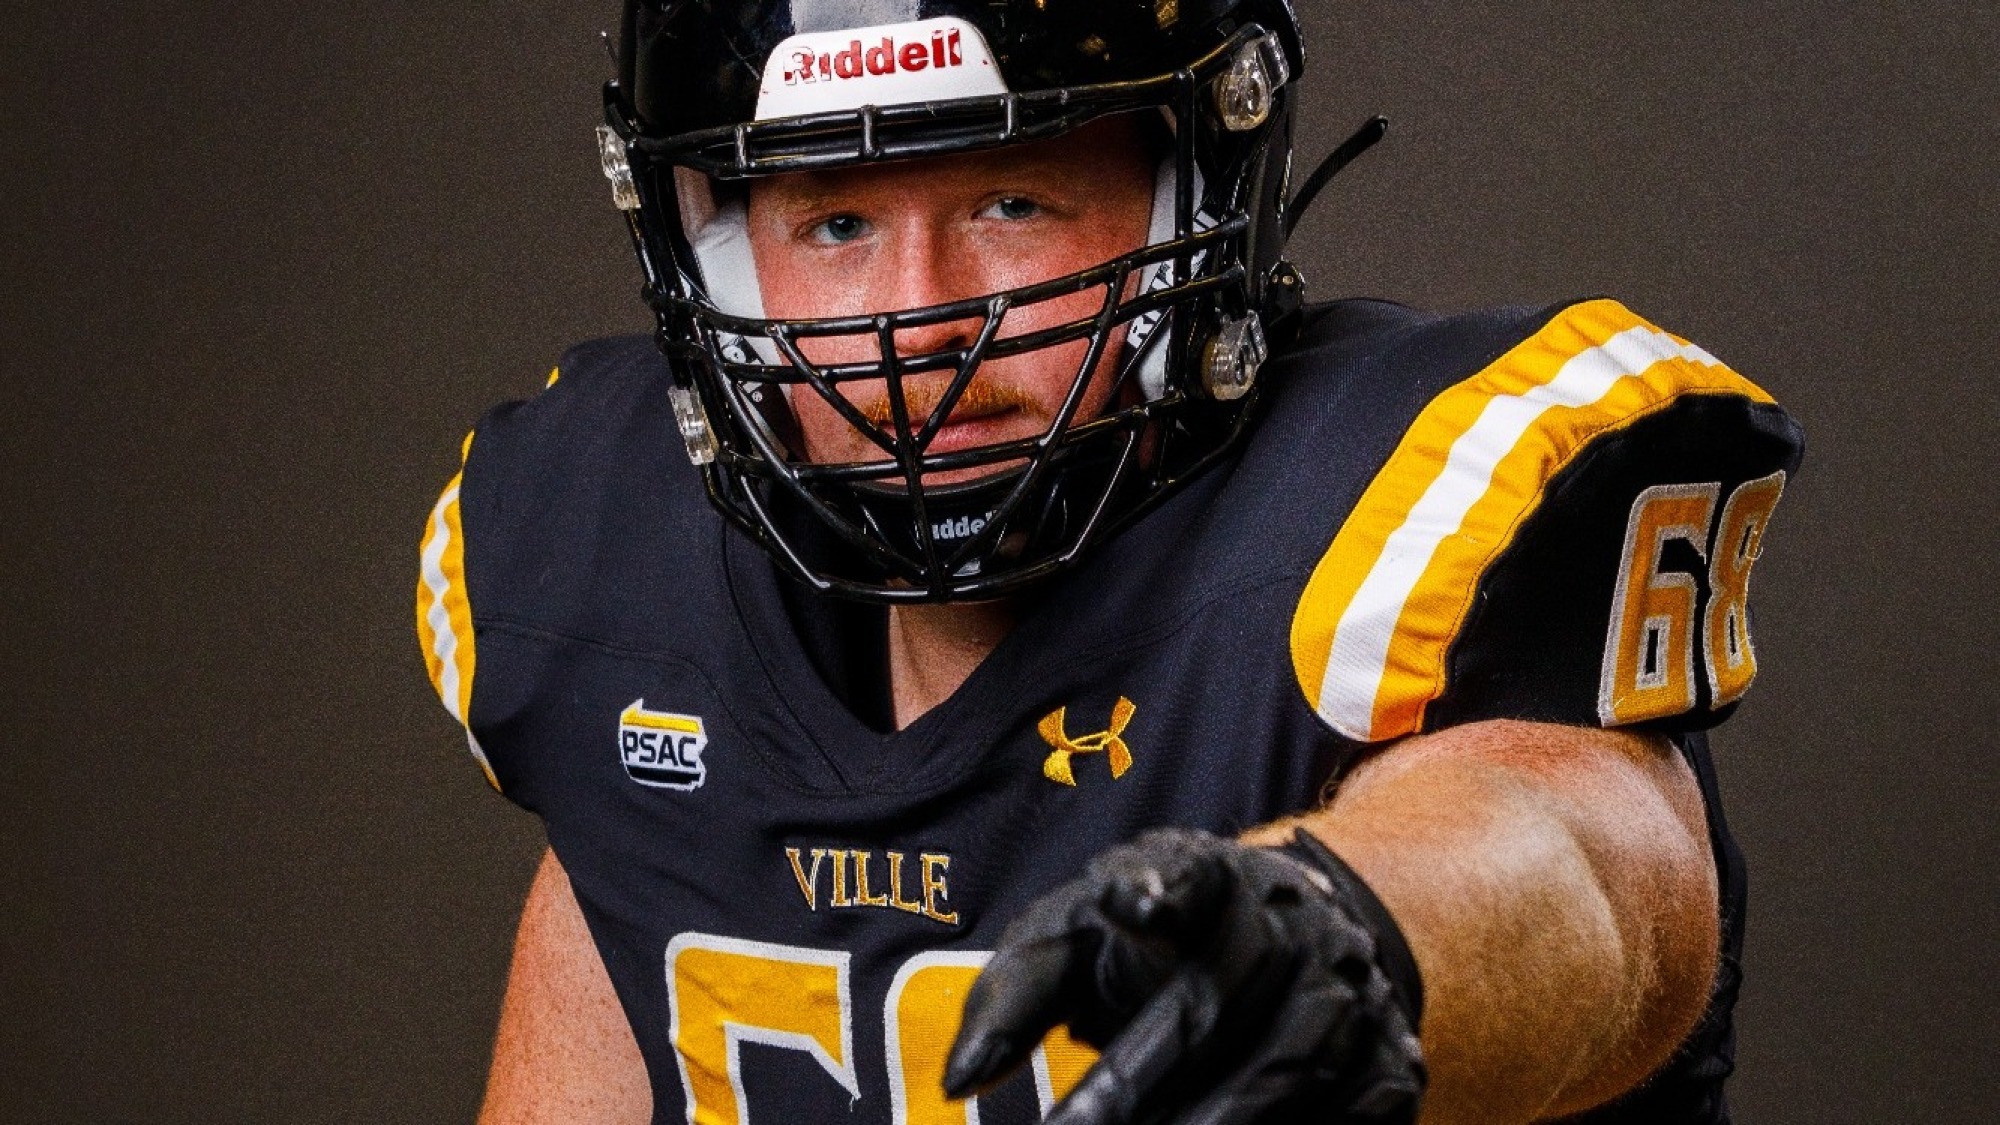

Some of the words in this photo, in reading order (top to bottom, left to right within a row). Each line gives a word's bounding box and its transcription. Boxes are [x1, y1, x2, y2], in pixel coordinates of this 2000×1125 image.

[783, 27, 962, 86] Riddell
[1597, 469, 1786, 728] 68
[622, 729, 698, 769] PSAC
[785, 847, 959, 925] VILLE
